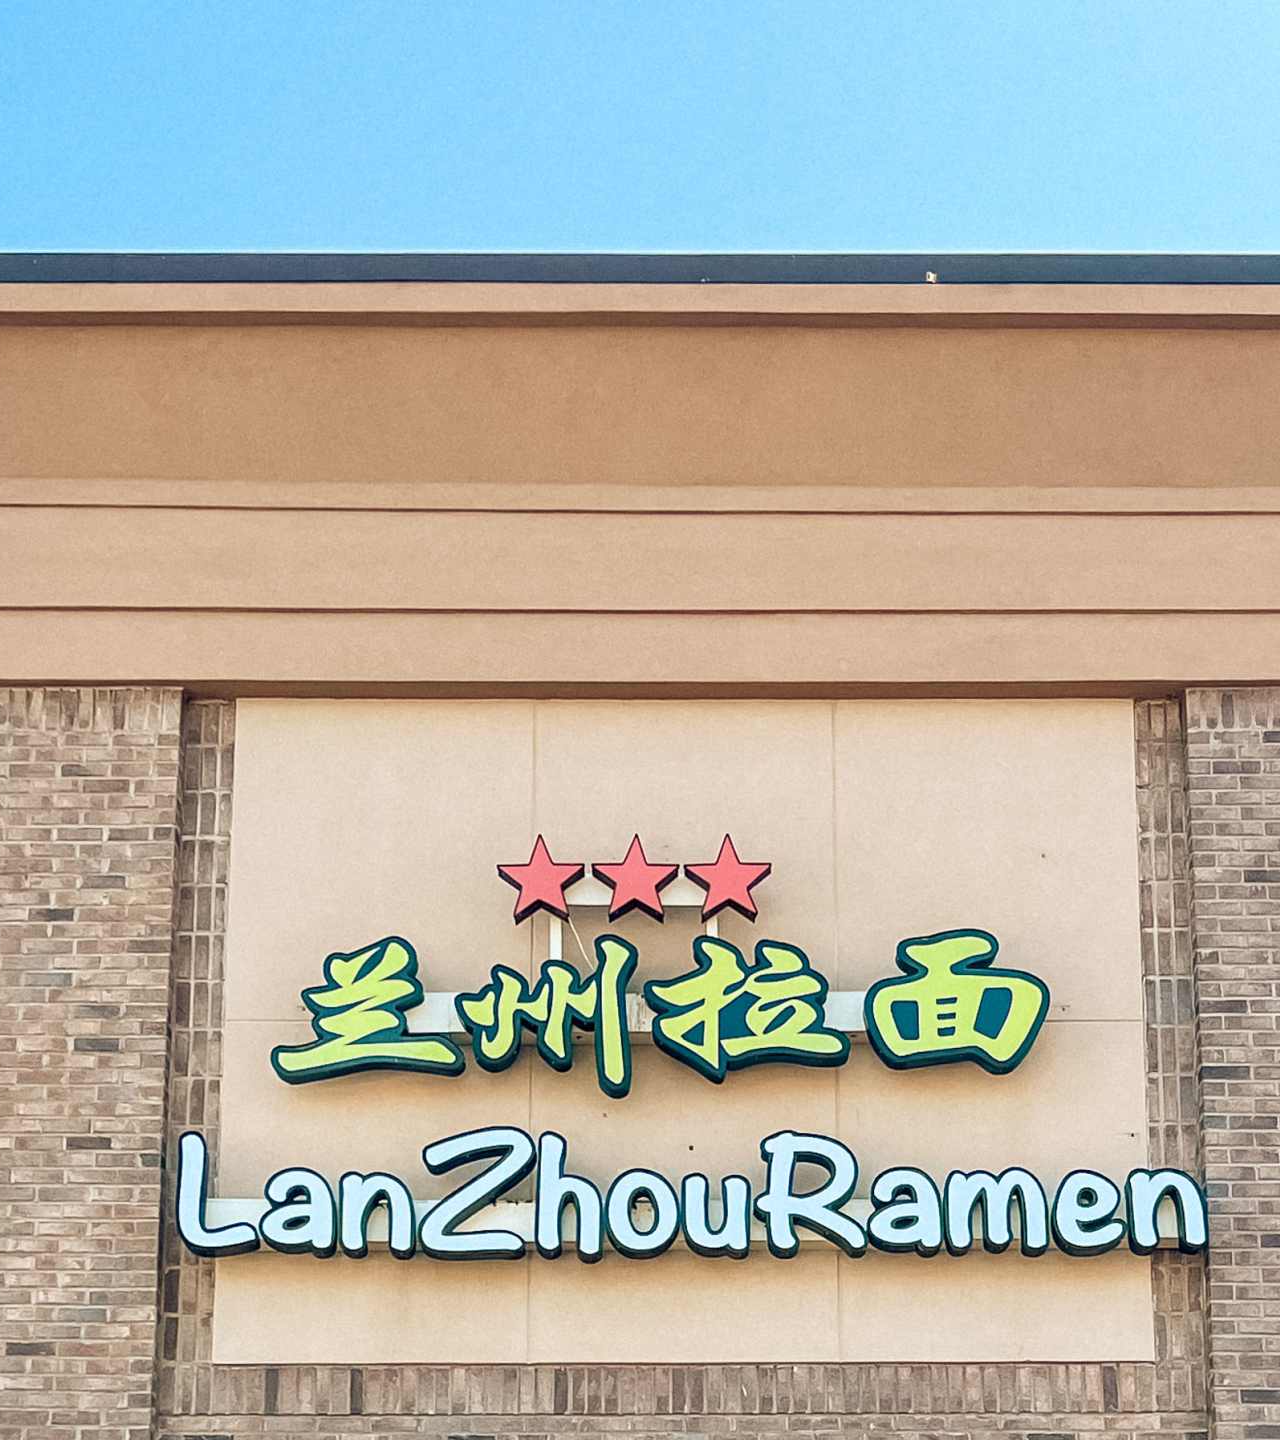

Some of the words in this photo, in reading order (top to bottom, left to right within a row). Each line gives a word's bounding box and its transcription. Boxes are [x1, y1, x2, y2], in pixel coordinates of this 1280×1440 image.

[271, 928, 1049, 1098] 兰州拉面
[177, 1126, 1207, 1262] LanZhouRamen
